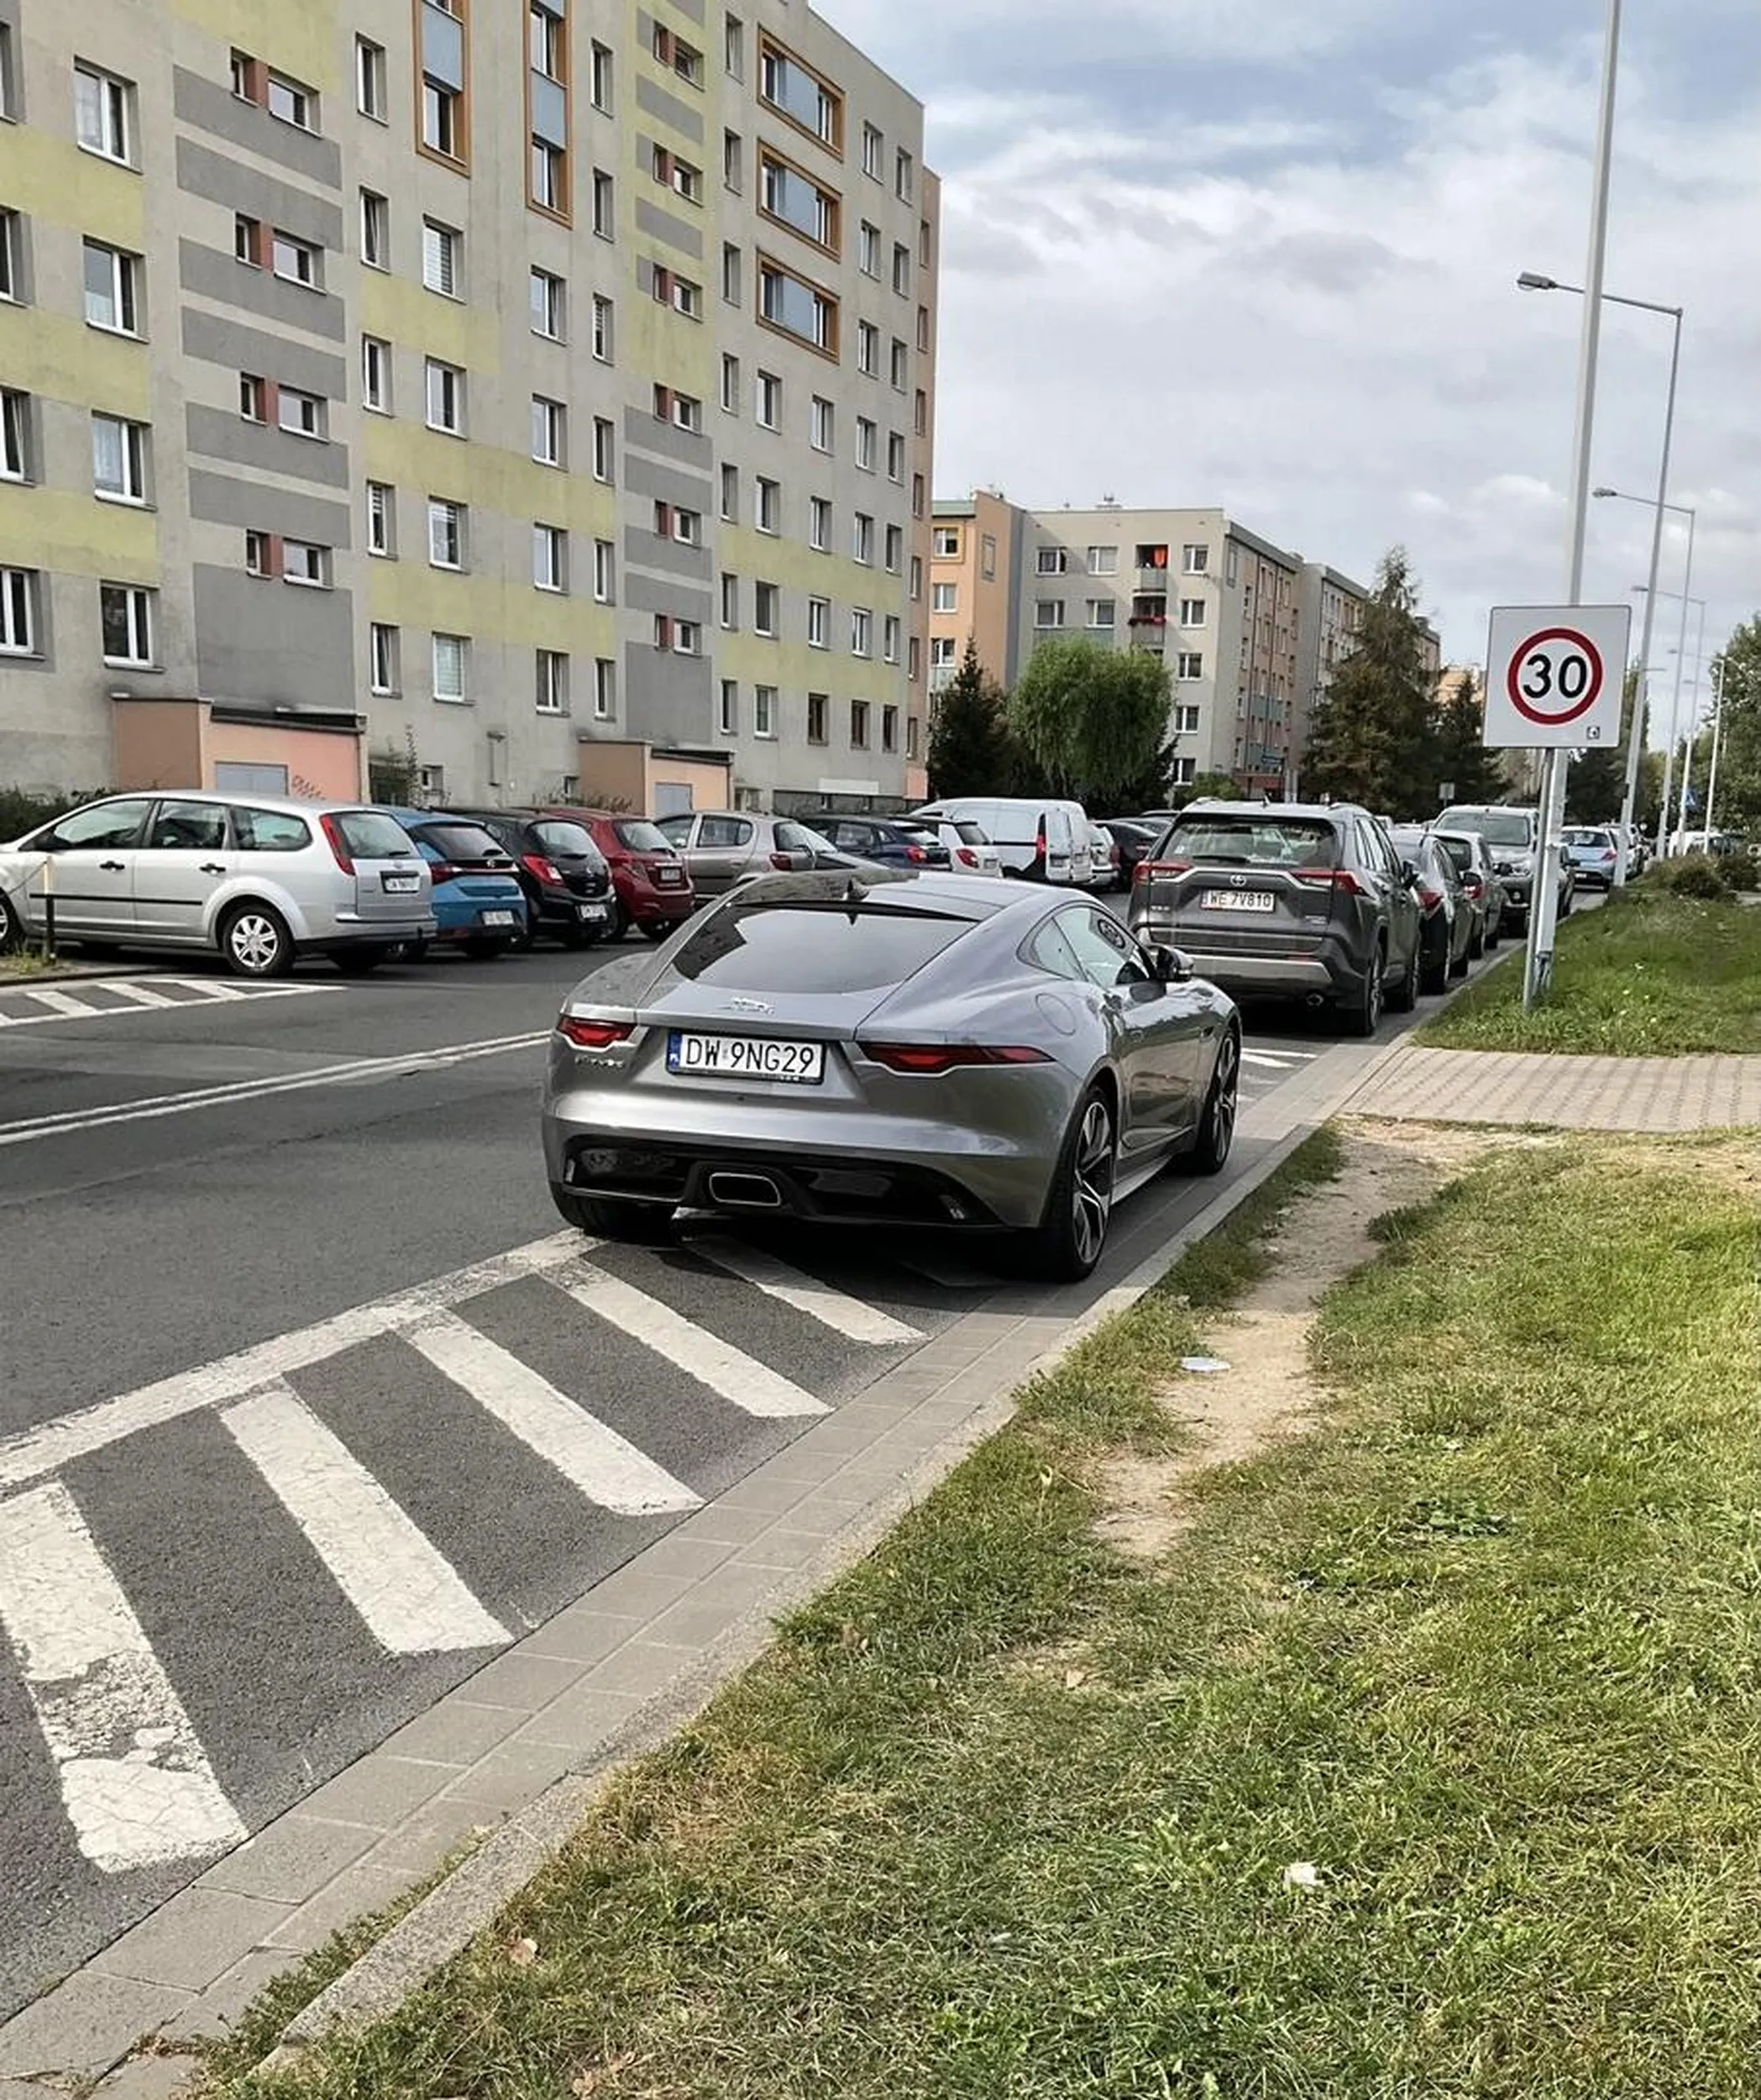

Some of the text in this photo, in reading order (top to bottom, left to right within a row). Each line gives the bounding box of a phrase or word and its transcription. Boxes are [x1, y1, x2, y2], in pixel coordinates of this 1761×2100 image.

[1523, 654, 1587, 699] 30
[1231, 892, 1272, 908] 7V810
[686, 1038, 815, 1074] DW 9NG29
